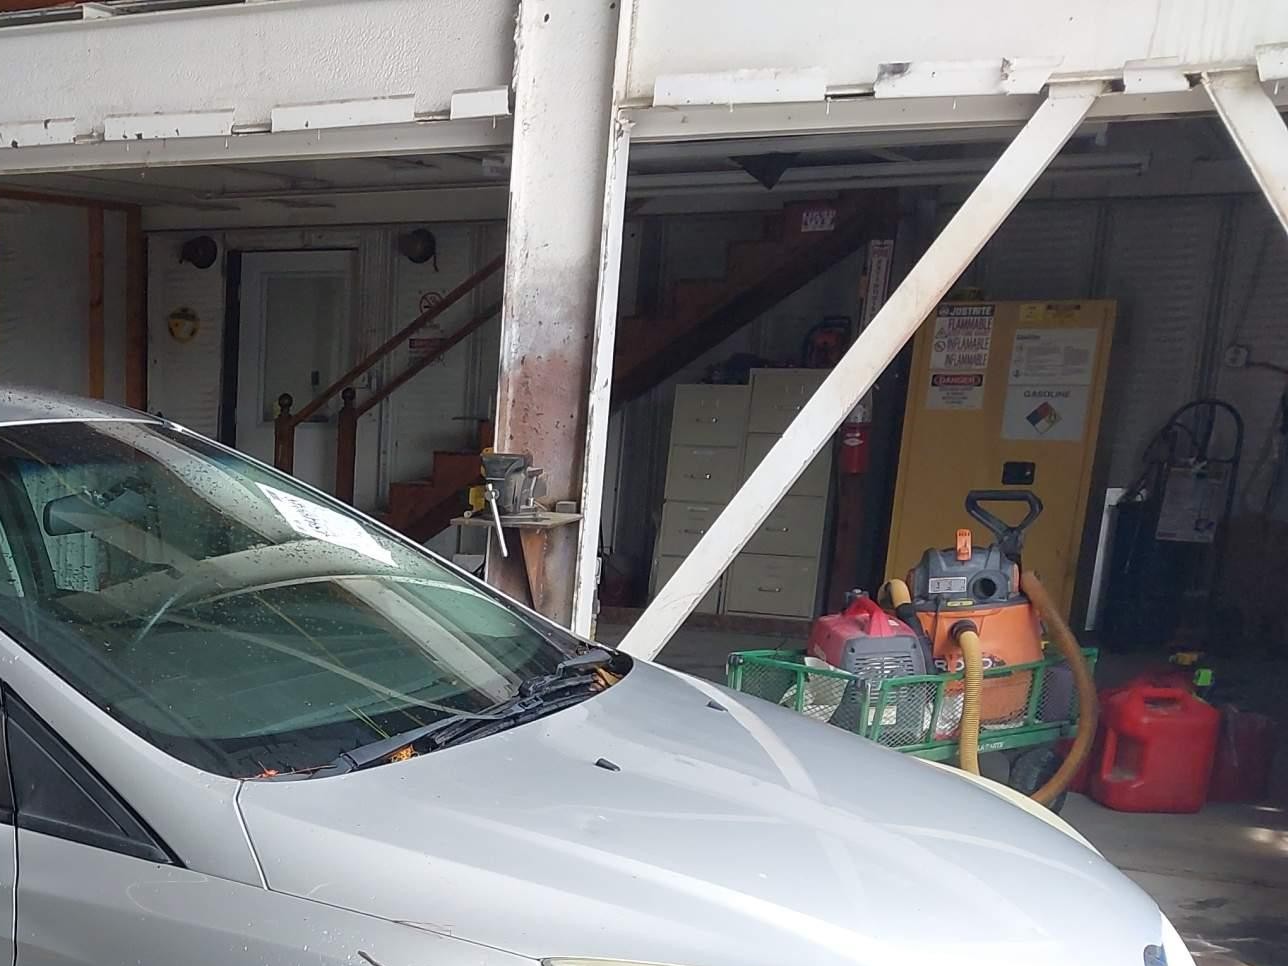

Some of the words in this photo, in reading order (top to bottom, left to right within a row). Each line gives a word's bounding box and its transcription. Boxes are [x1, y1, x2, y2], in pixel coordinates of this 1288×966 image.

[949, 306, 992, 316] JUSTRITE
[947, 317, 991, 330] FLAMMABLE
[940, 375, 975, 384] DANGER
[1023, 390, 1071, 398] GASOLINE
